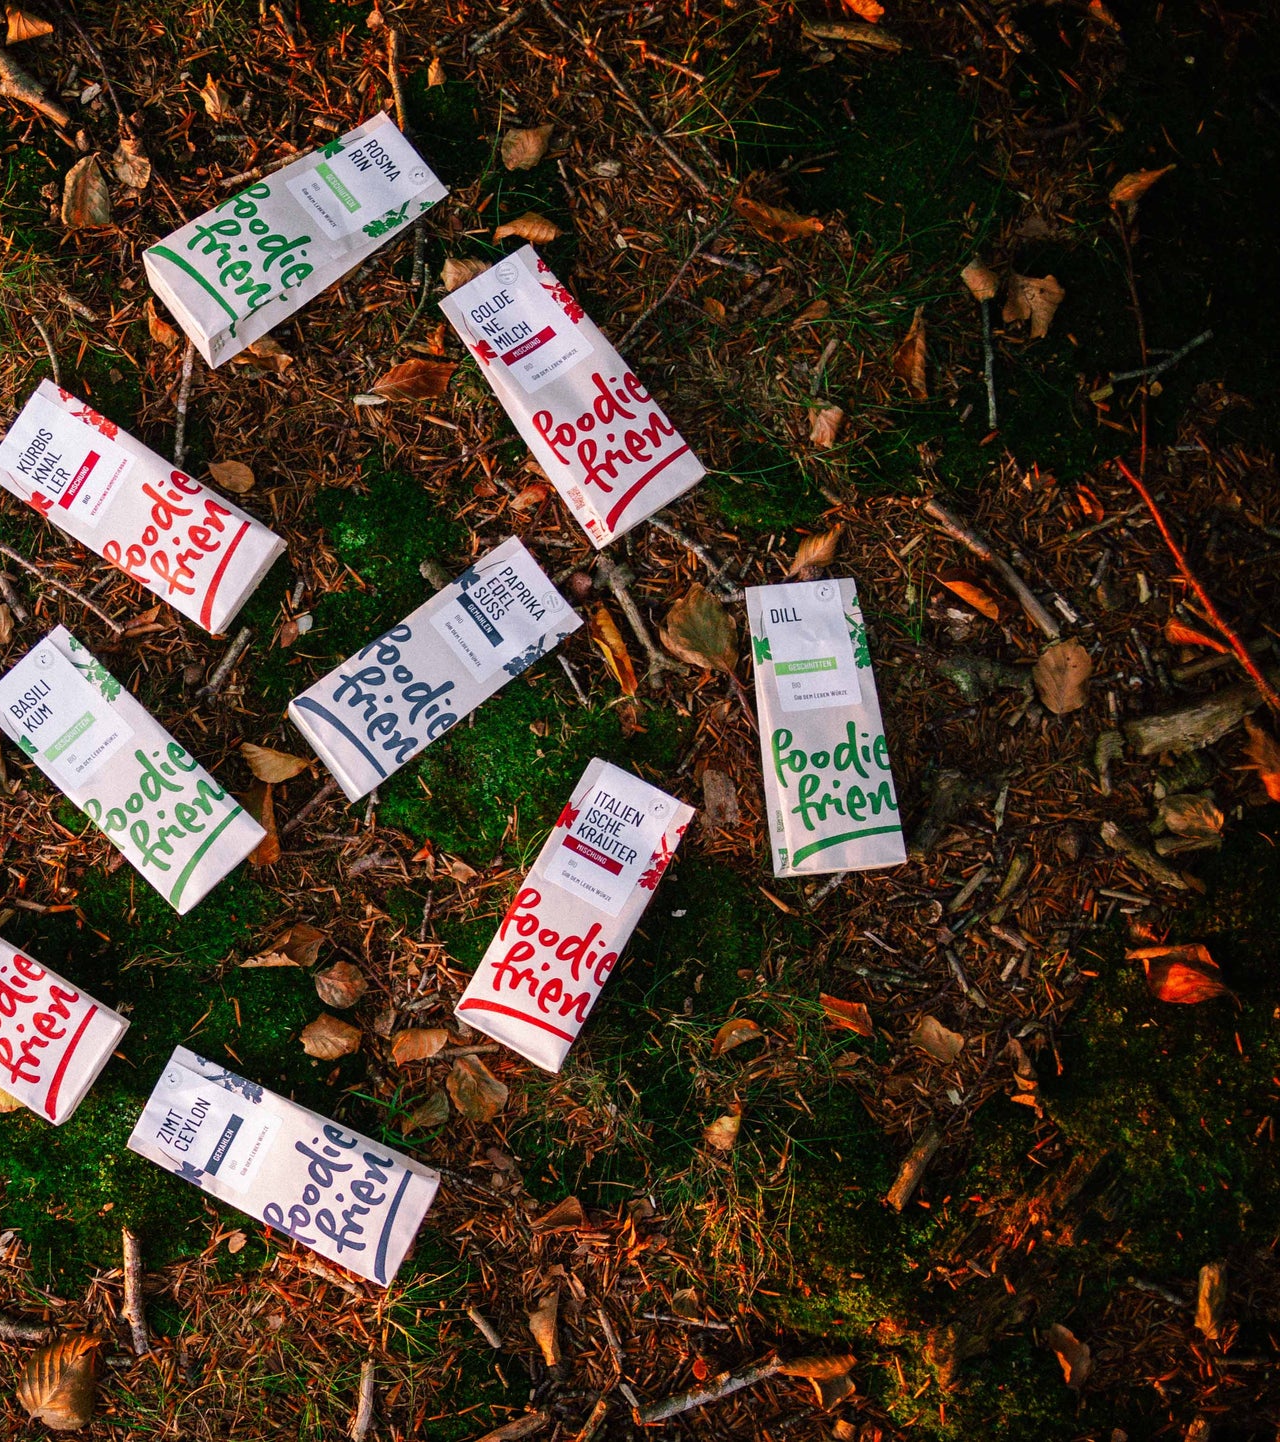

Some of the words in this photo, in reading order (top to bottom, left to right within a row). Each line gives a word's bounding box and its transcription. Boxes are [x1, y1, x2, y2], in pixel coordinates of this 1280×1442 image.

[348, 149, 372, 171] RIN
[363, 139, 400, 182] ROSMA
[215, 183, 314, 289] foodie
[471, 289, 514, 323] GOLDE
[482, 318, 504, 336] NE
[493, 321, 532, 350] MILCH
[512, 336, 541, 357] MISCHUNG
[532, 371, 651, 465] foodie
[17, 429, 52, 474] KÜRBIS
[32, 452, 62, 484] KNAL
[47, 468, 70, 494] LER
[67, 465, 89, 495] MISCHUNG
[103, 470, 203, 584] foodie
[487, 577, 514, 611] EDEL
[499, 567, 545, 621] PAPRIKA
[467, 603, 493, 633] GEMAHLEN
[770, 608, 802, 623] DILL
[10, 680, 51, 719] BASILI
[358, 624, 458, 740] foodie
[23, 704, 53, 732] KUM
[771, 721, 890, 788] foodie
[84, 742, 199, 850] foodie
[594, 791, 644, 827] ITALIEN
[585, 807, 625, 837] ISCHE
[576, 843, 607, 864] MISCHUNG
[577, 823, 637, 864] KRÄUTER
[499, 888, 618, 987] foodie
[157, 1109, 182, 1144] ZIMT
[174, 1098, 210, 1151] CEYLON
[212, 1128, 234, 1161] GEMAHLEN
[263, 1124, 358, 1244] foodie
